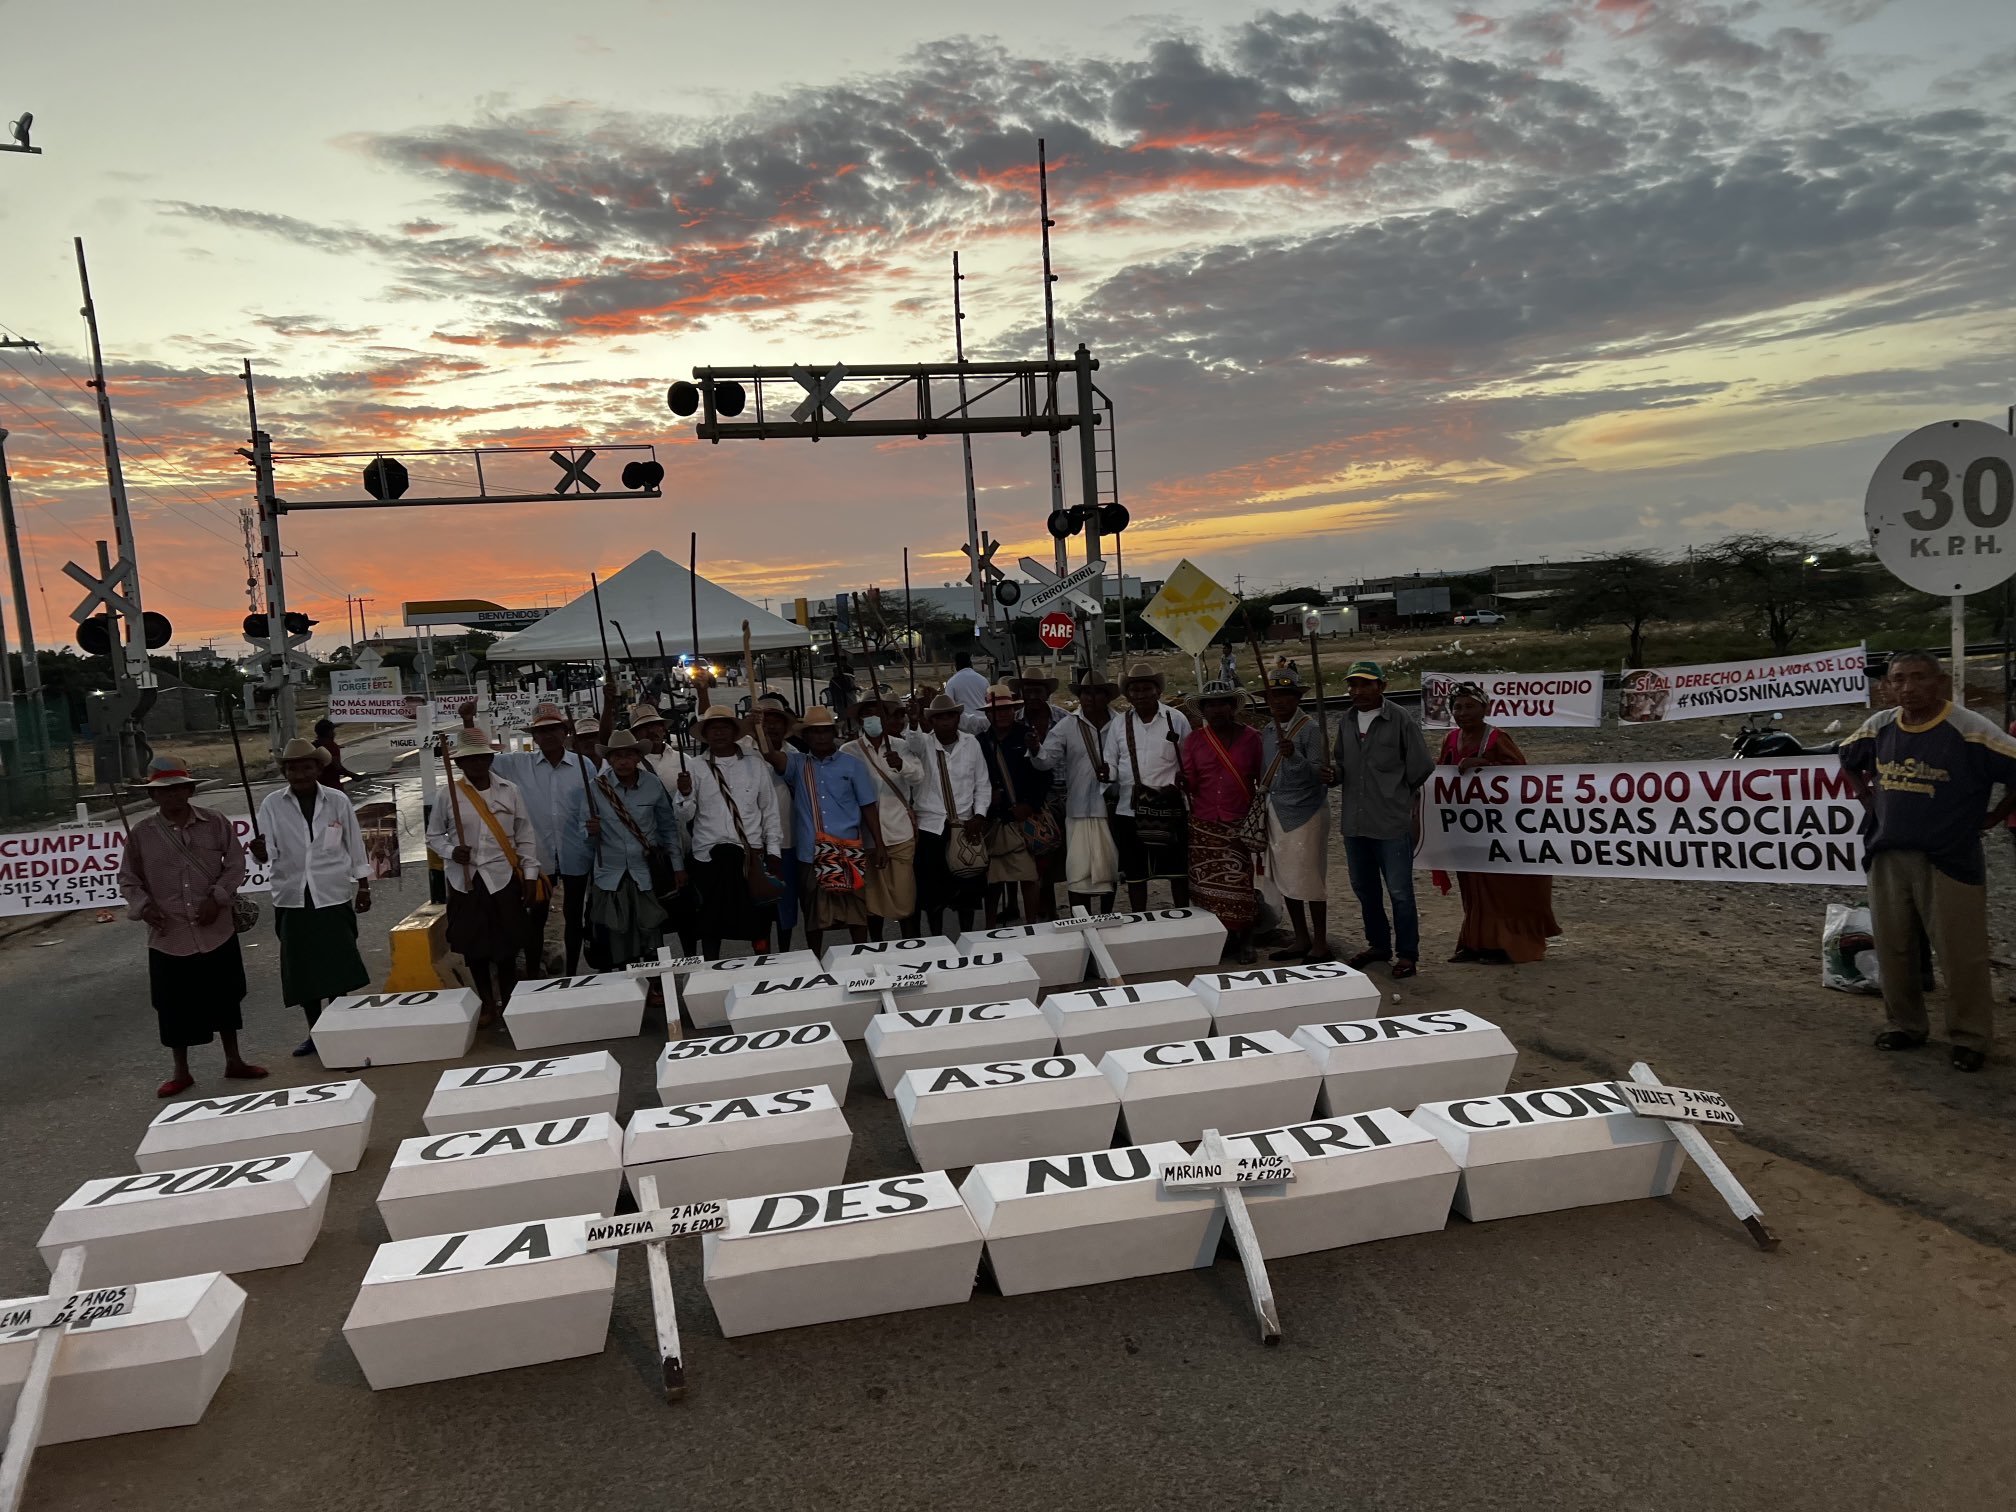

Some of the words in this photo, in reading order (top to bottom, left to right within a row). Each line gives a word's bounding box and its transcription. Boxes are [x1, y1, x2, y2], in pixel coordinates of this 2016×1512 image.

[1902, 456, 2014, 531] 30
[1031, 567, 1096, 607] FERROCARRIL
[478, 610, 540, 620] BIENVENIDOS
[1041, 623, 1072, 638] PARE
[1676, 670, 1742, 689] DERECHO
[1745, 668, 1755, 681] A
[1759, 666, 1776, 679] LA
[1818, 659, 1834, 673] DE
[1837, 656, 1866, 670] LOS
[338, 682, 367, 692] JORGE
[1493, 680, 1592, 695] GENOCIDIO
[1677, 675, 1866, 708] #NIÑOSNIÑASWAYUU
[390, 739, 417, 747] MIGUEL
[1434, 765, 1509, 805] MÁS
[1520, 774, 1563, 805] DE
[1574, 770, 1691, 804] 5.000
[1441, 807, 1508, 833] POR
[1515, 806, 1657, 834] CAUSAS
[1488, 840, 1510, 863] A
[1520, 838, 1564, 865] LA
[1572, 830, 1857, 872] DESNUTRICIÓN
[21, 892, 80, 908] T-415,
[85, 887, 125, 902] T-3
[46, 878, 60, 891] Y
[986, 925, 1036, 940] CI
[1054, 917, 1088, 927] VITELIO
[851, 938, 927, 956] NO
[711, 953, 781, 971] GE
[898, 952, 1004, 974] YUU
[533, 975, 604, 992] AL
[750, 973, 839, 996] WA
[849, 978, 876, 988] DAVID
[1215, 963, 1348, 990] MAS
[348, 991, 440, 1009] NO
[1074, 986, 1141, 1008] TI
[897, 1002, 1011, 1028] VIC
[1321, 1012, 1469, 1045] DAS
[1143, 1035, 1274, 1066] CIA
[458, 1057, 571, 1087] DE
[928, 1057, 1077, 1093] ASO
[158, 1083, 348, 1124] MAS
[655, 1088, 816, 1129] SAS
[1447, 1082, 1633, 1129] CION
[1626, 1087, 1676, 1106] YULIET
[1679, 1090, 1692, 1102] 3
[1694, 1092, 1726, 1107] AÑOS
[1683, 1106, 1699, 1117] DE
[1706, 1109, 1736, 1122] EDAD
[420, 1116, 590, 1162] CAU
[1226, 1114, 1393, 1158] TRI
[84, 1156, 292, 1207] POR
[1025, 1147, 1152, 1195] NU
[1164, 1164, 1222, 1182] MARIANO
[1238, 1158, 1249, 1169] 4
[1252, 1156, 1284, 1169] AÑOS
[1236, 1172, 1253, 1182] DE
[1257, 1167, 1292, 1180] EDAD
[748, 1177, 929, 1234] DES
[587, 1221, 654, 1242] ANDREINA
[671, 1208, 681, 1221] 2
[683, 1200, 721, 1218] AÑOS
[671, 1222, 688, 1235] DE
[690, 1216, 724, 1232] EDAD
[416, 1223, 553, 1276] LA
[63, 1295, 79, 1310] 2
[80, 1287, 128, 1307] AÑOS
[49, 1309, 77, 1326] DE
[79, 1302, 125, 1321] EDAD
